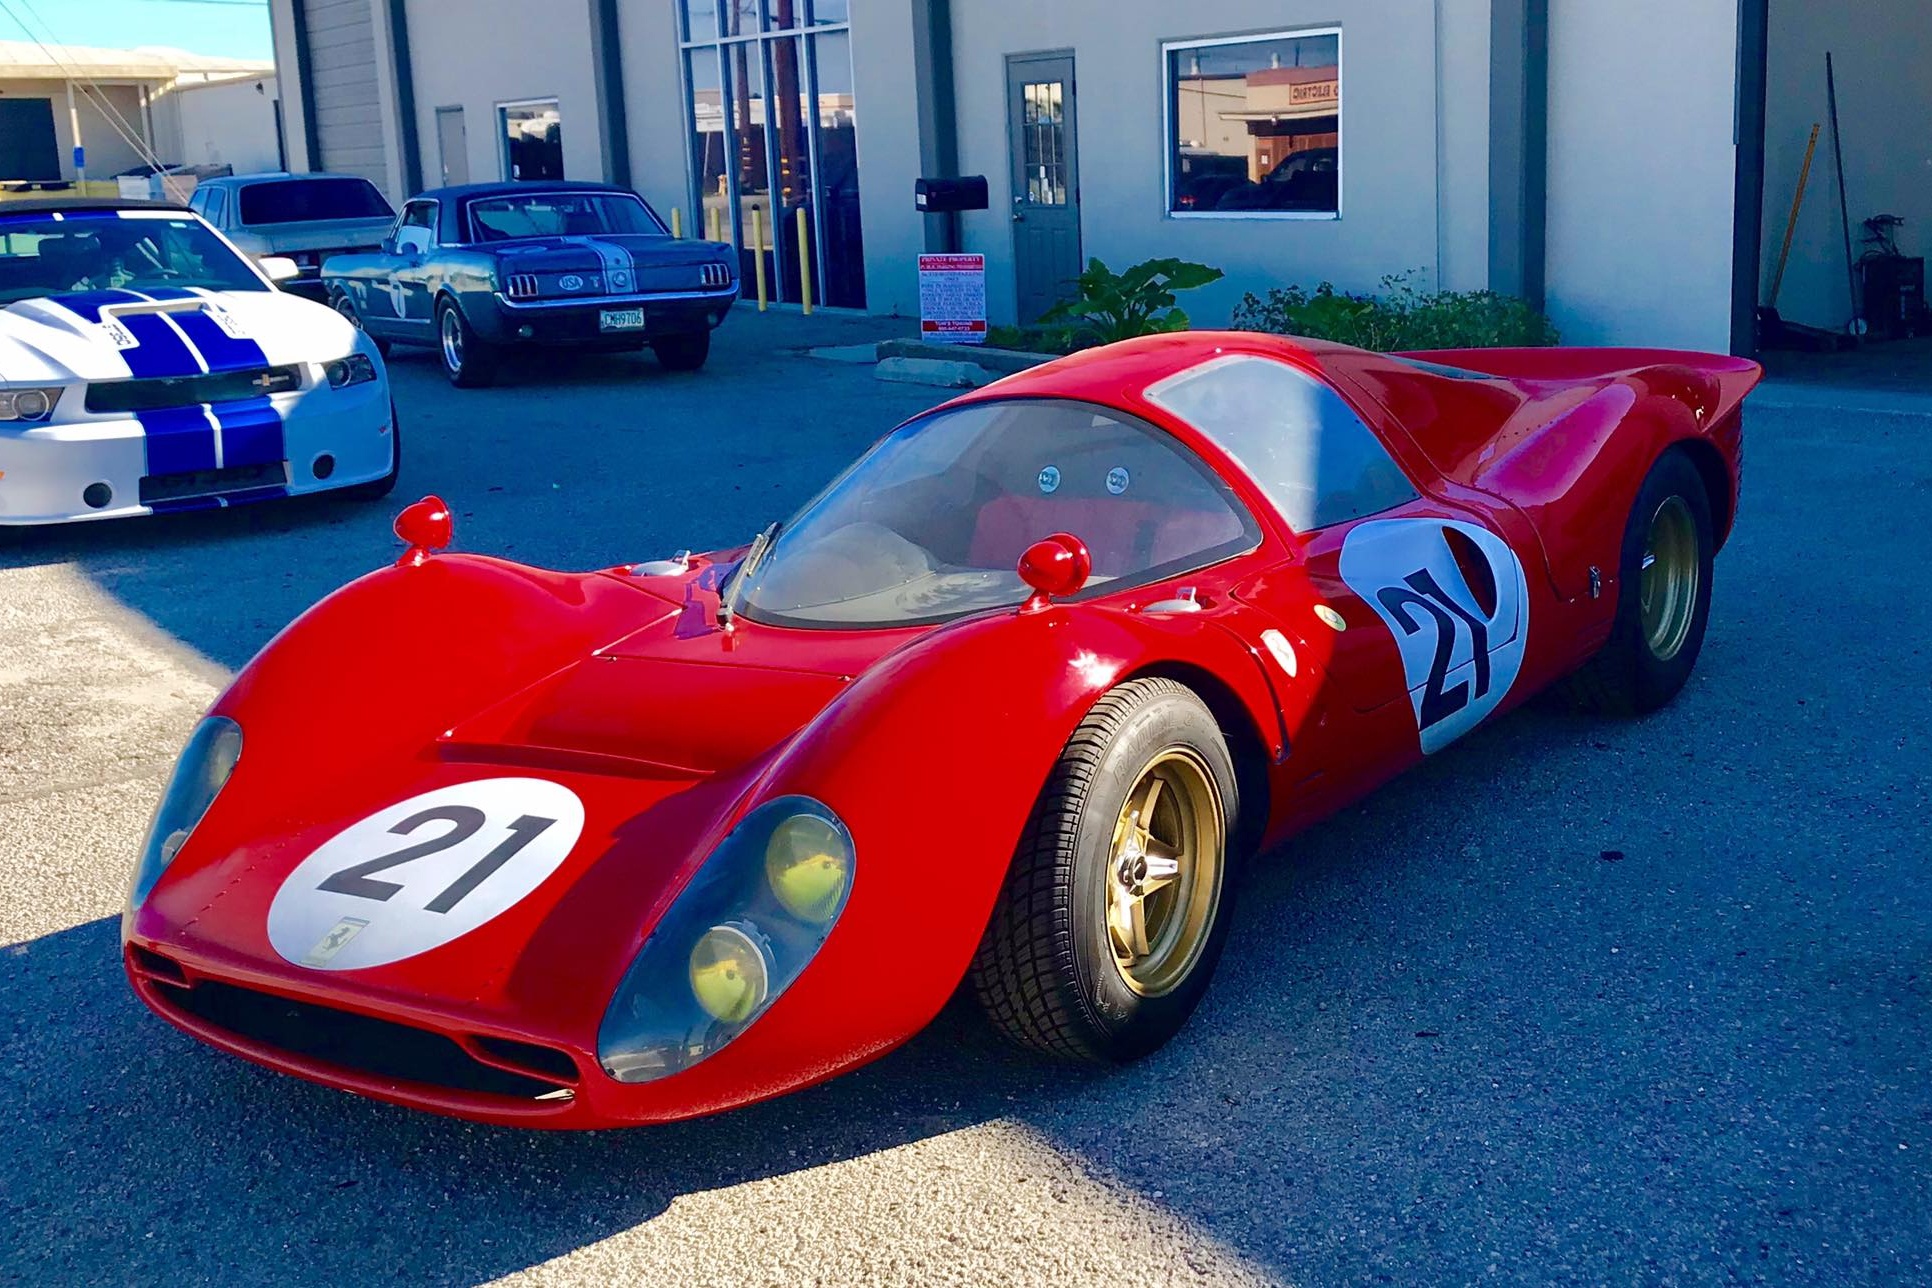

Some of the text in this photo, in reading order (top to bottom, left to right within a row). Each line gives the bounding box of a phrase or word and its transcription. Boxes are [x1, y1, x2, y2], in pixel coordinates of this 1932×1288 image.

[561, 275, 581, 288] USA
[1376, 567, 1491, 732] 21
[316, 804, 558, 915] 21
